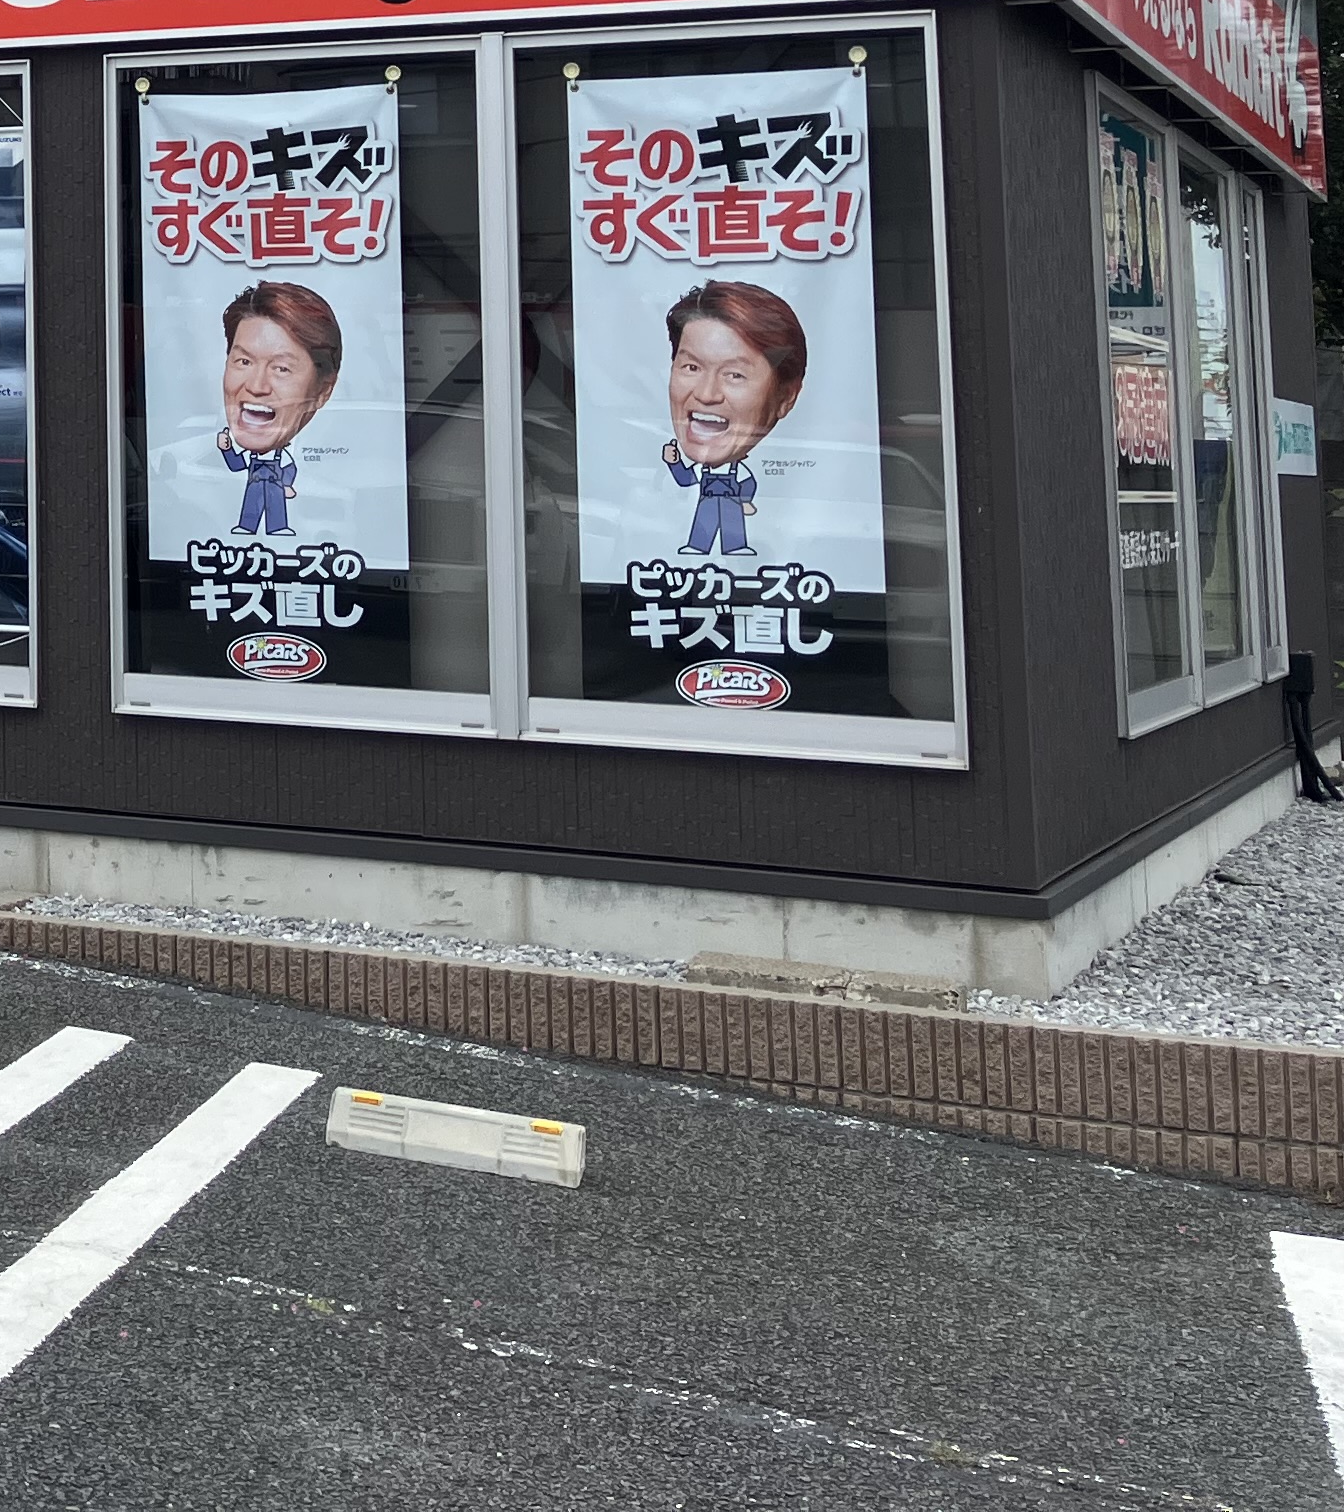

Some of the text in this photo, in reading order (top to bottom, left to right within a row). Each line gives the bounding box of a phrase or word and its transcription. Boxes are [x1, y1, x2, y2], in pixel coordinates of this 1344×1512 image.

[190, 542, 362, 580] ピッカーズの
[631, 563, 830, 604] ピッカーズの
[189, 578, 364, 628] キズ直し
[629, 602, 834, 655] キズ直し
